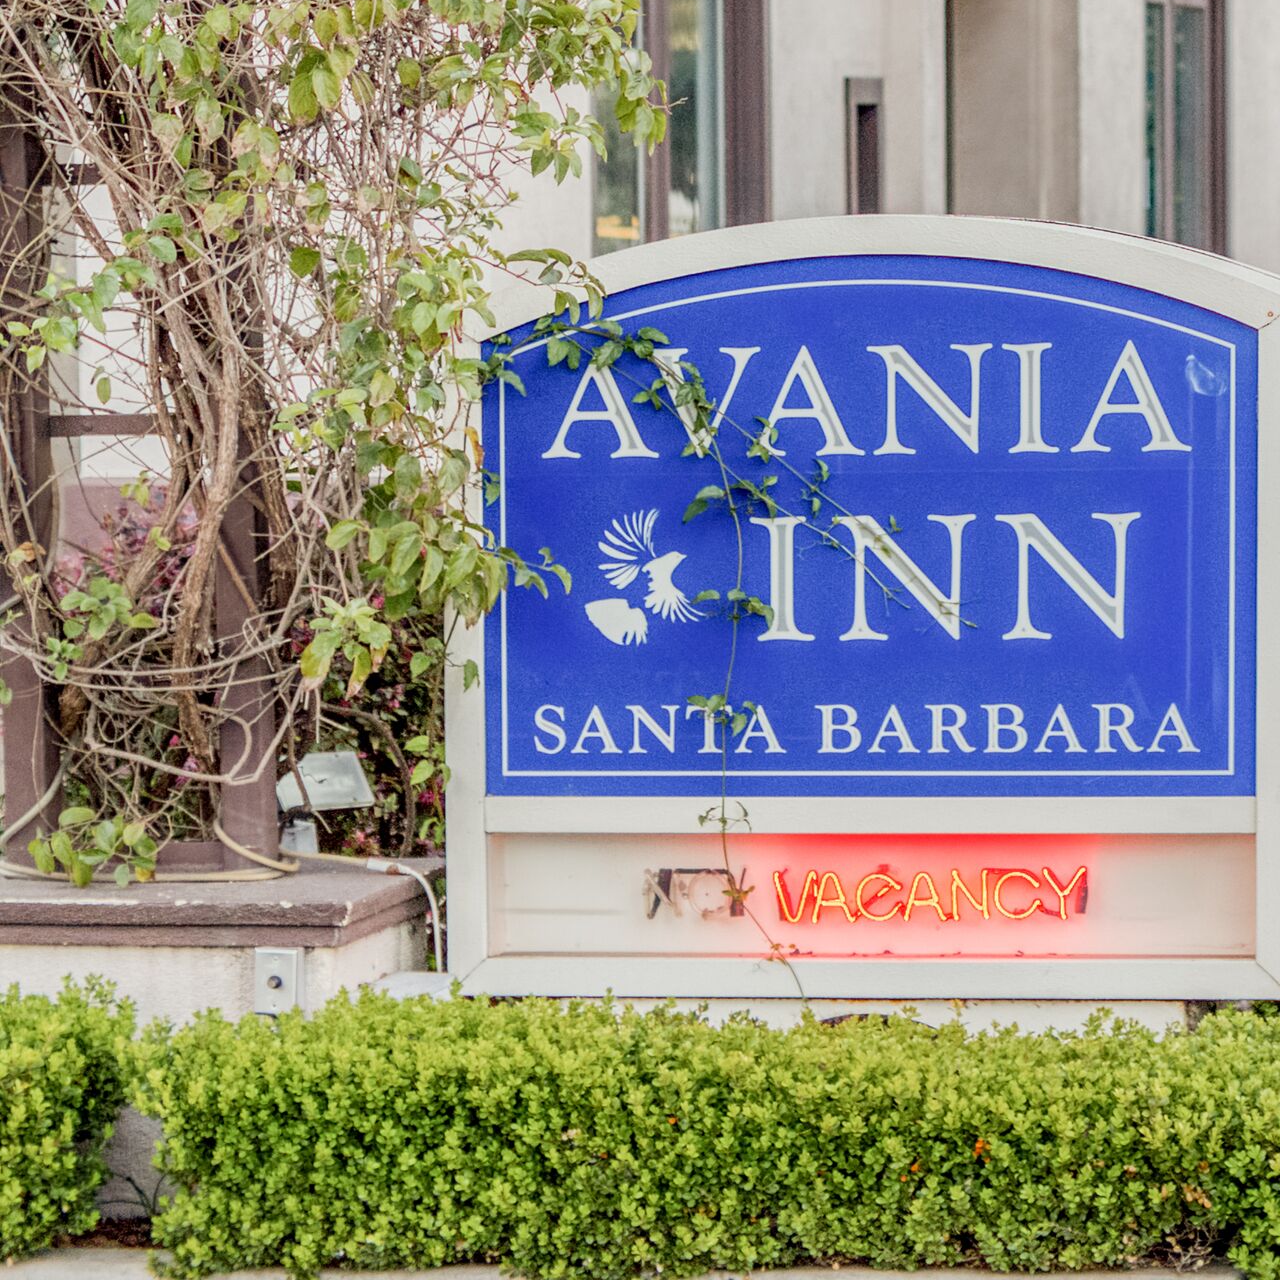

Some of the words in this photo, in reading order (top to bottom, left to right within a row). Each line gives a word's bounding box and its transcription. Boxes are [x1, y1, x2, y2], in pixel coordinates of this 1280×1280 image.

[541, 339, 1193, 460] AVANIA
[749, 511, 1142, 643] INN
[533, 703, 787, 755] SANTA
[815, 702, 1201, 754] BARBARA
[773, 865, 1088, 924] VACANCY
